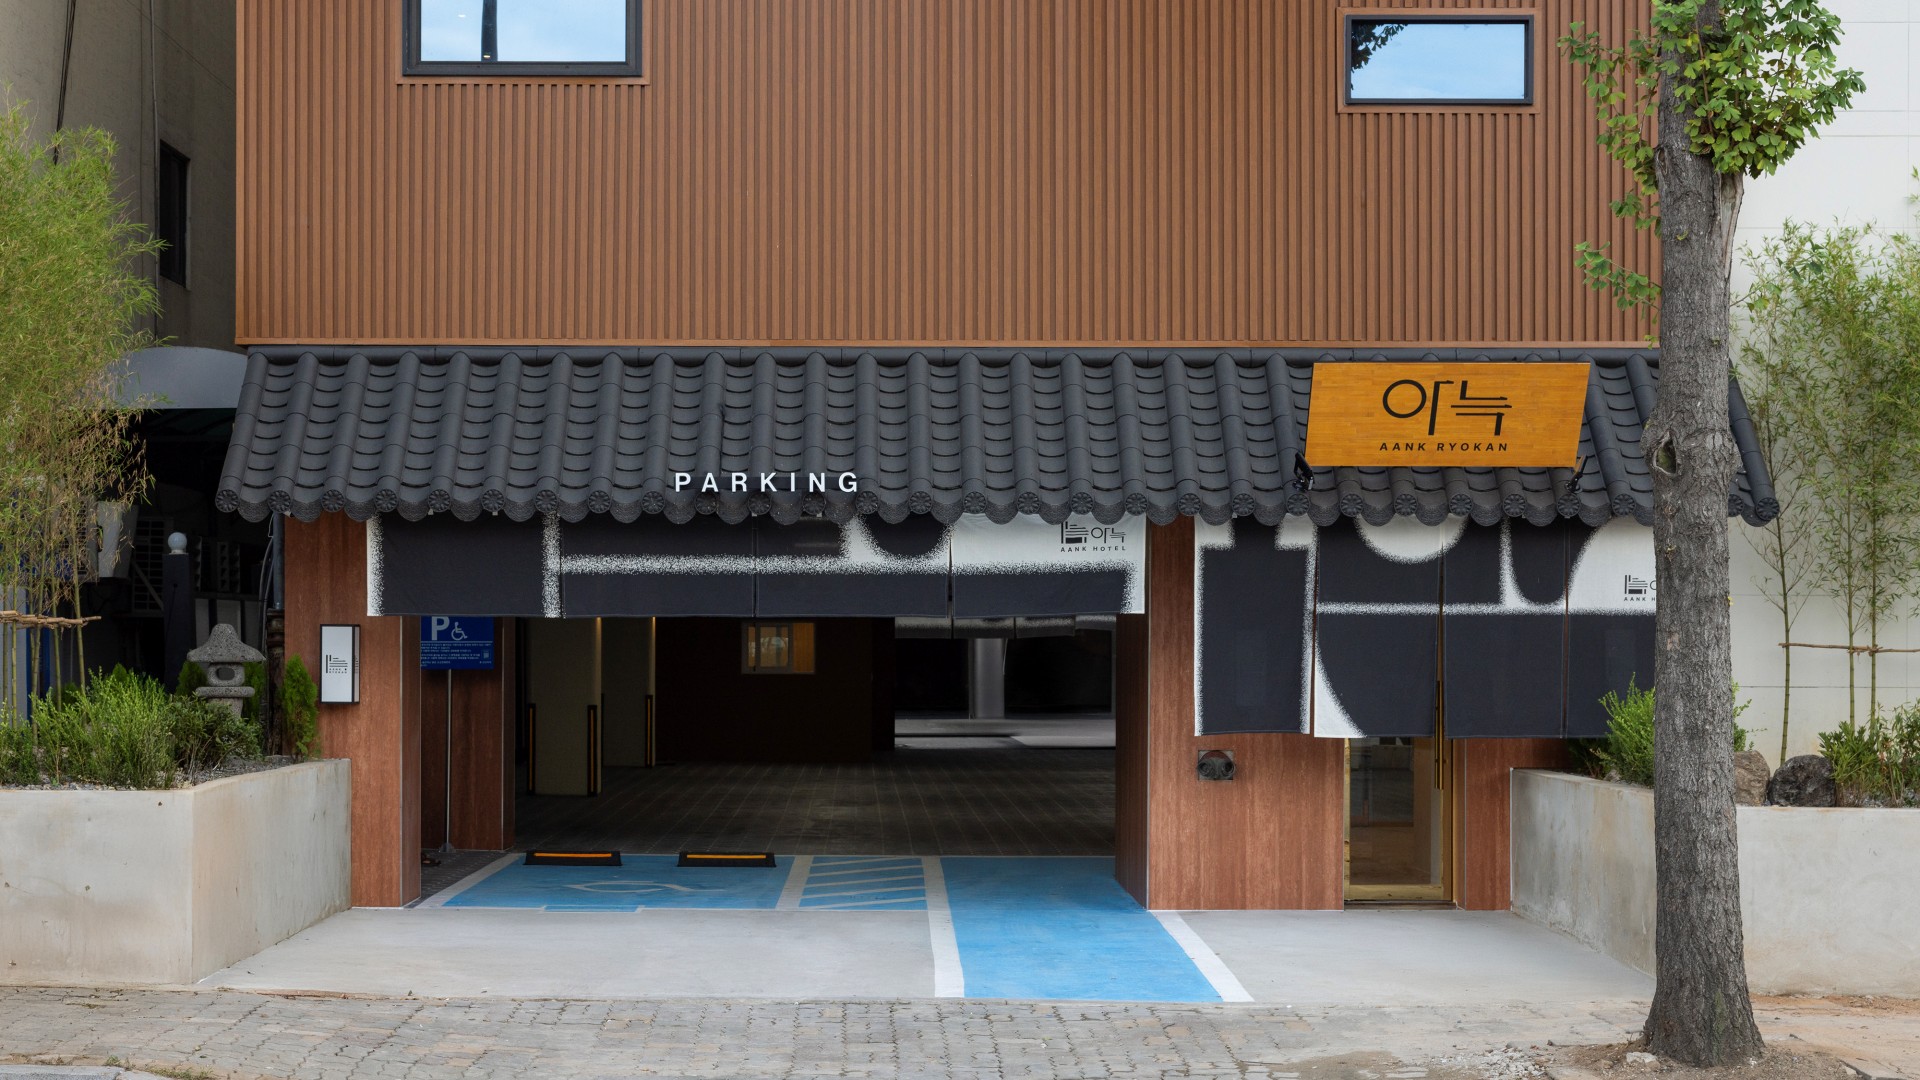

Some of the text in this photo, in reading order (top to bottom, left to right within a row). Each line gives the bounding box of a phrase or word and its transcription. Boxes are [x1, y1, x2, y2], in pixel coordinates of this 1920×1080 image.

[1383, 379, 1512, 436] 아늑
[1380, 442, 1508, 452] AANK RYOKAN
[674, 472, 858, 493] PARKING
[431, 616, 450, 641] P
